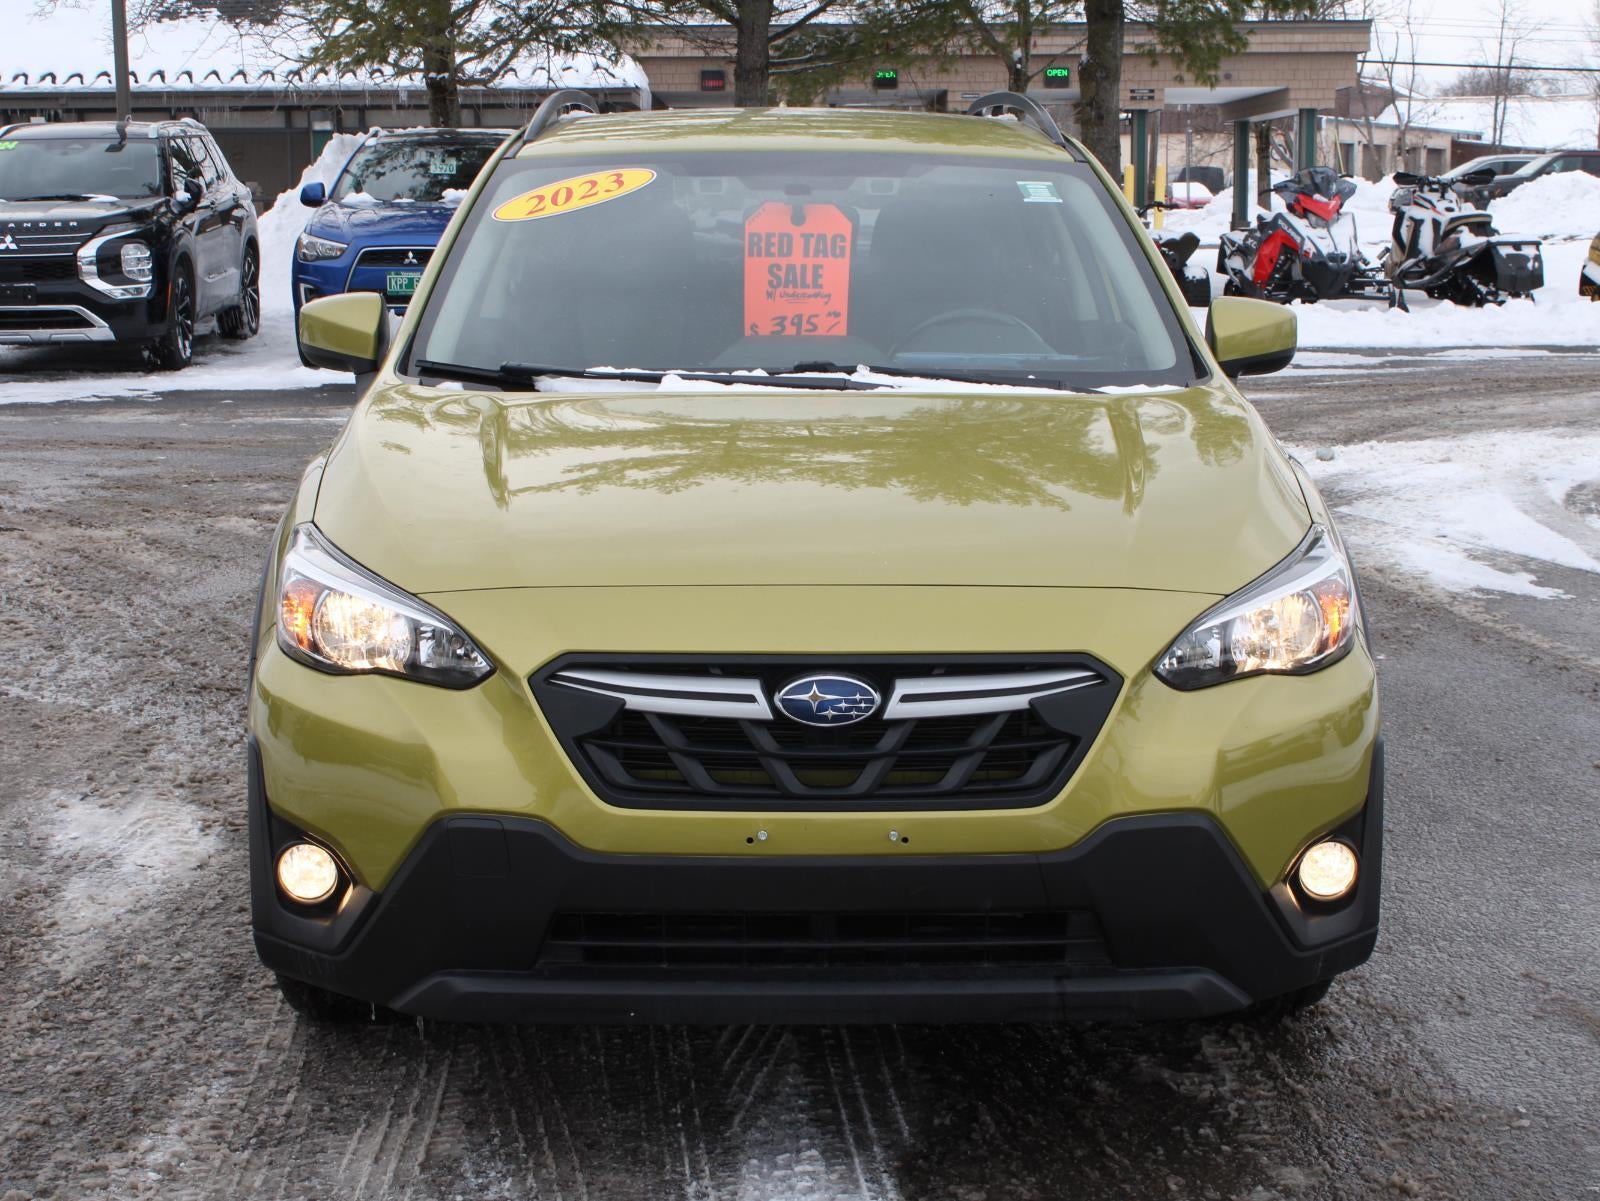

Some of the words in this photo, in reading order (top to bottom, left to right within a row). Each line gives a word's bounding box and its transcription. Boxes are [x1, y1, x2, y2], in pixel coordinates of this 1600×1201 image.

[1046, 69, 1068, 77] OPEN
[526, 172, 625, 216] 2023
[748, 232, 794, 258] RED
[801, 233, 847, 259] TAG
[391, 278, 408, 290] KPP
[768, 263, 824, 289] SALE
[769, 313, 820, 336] 395
